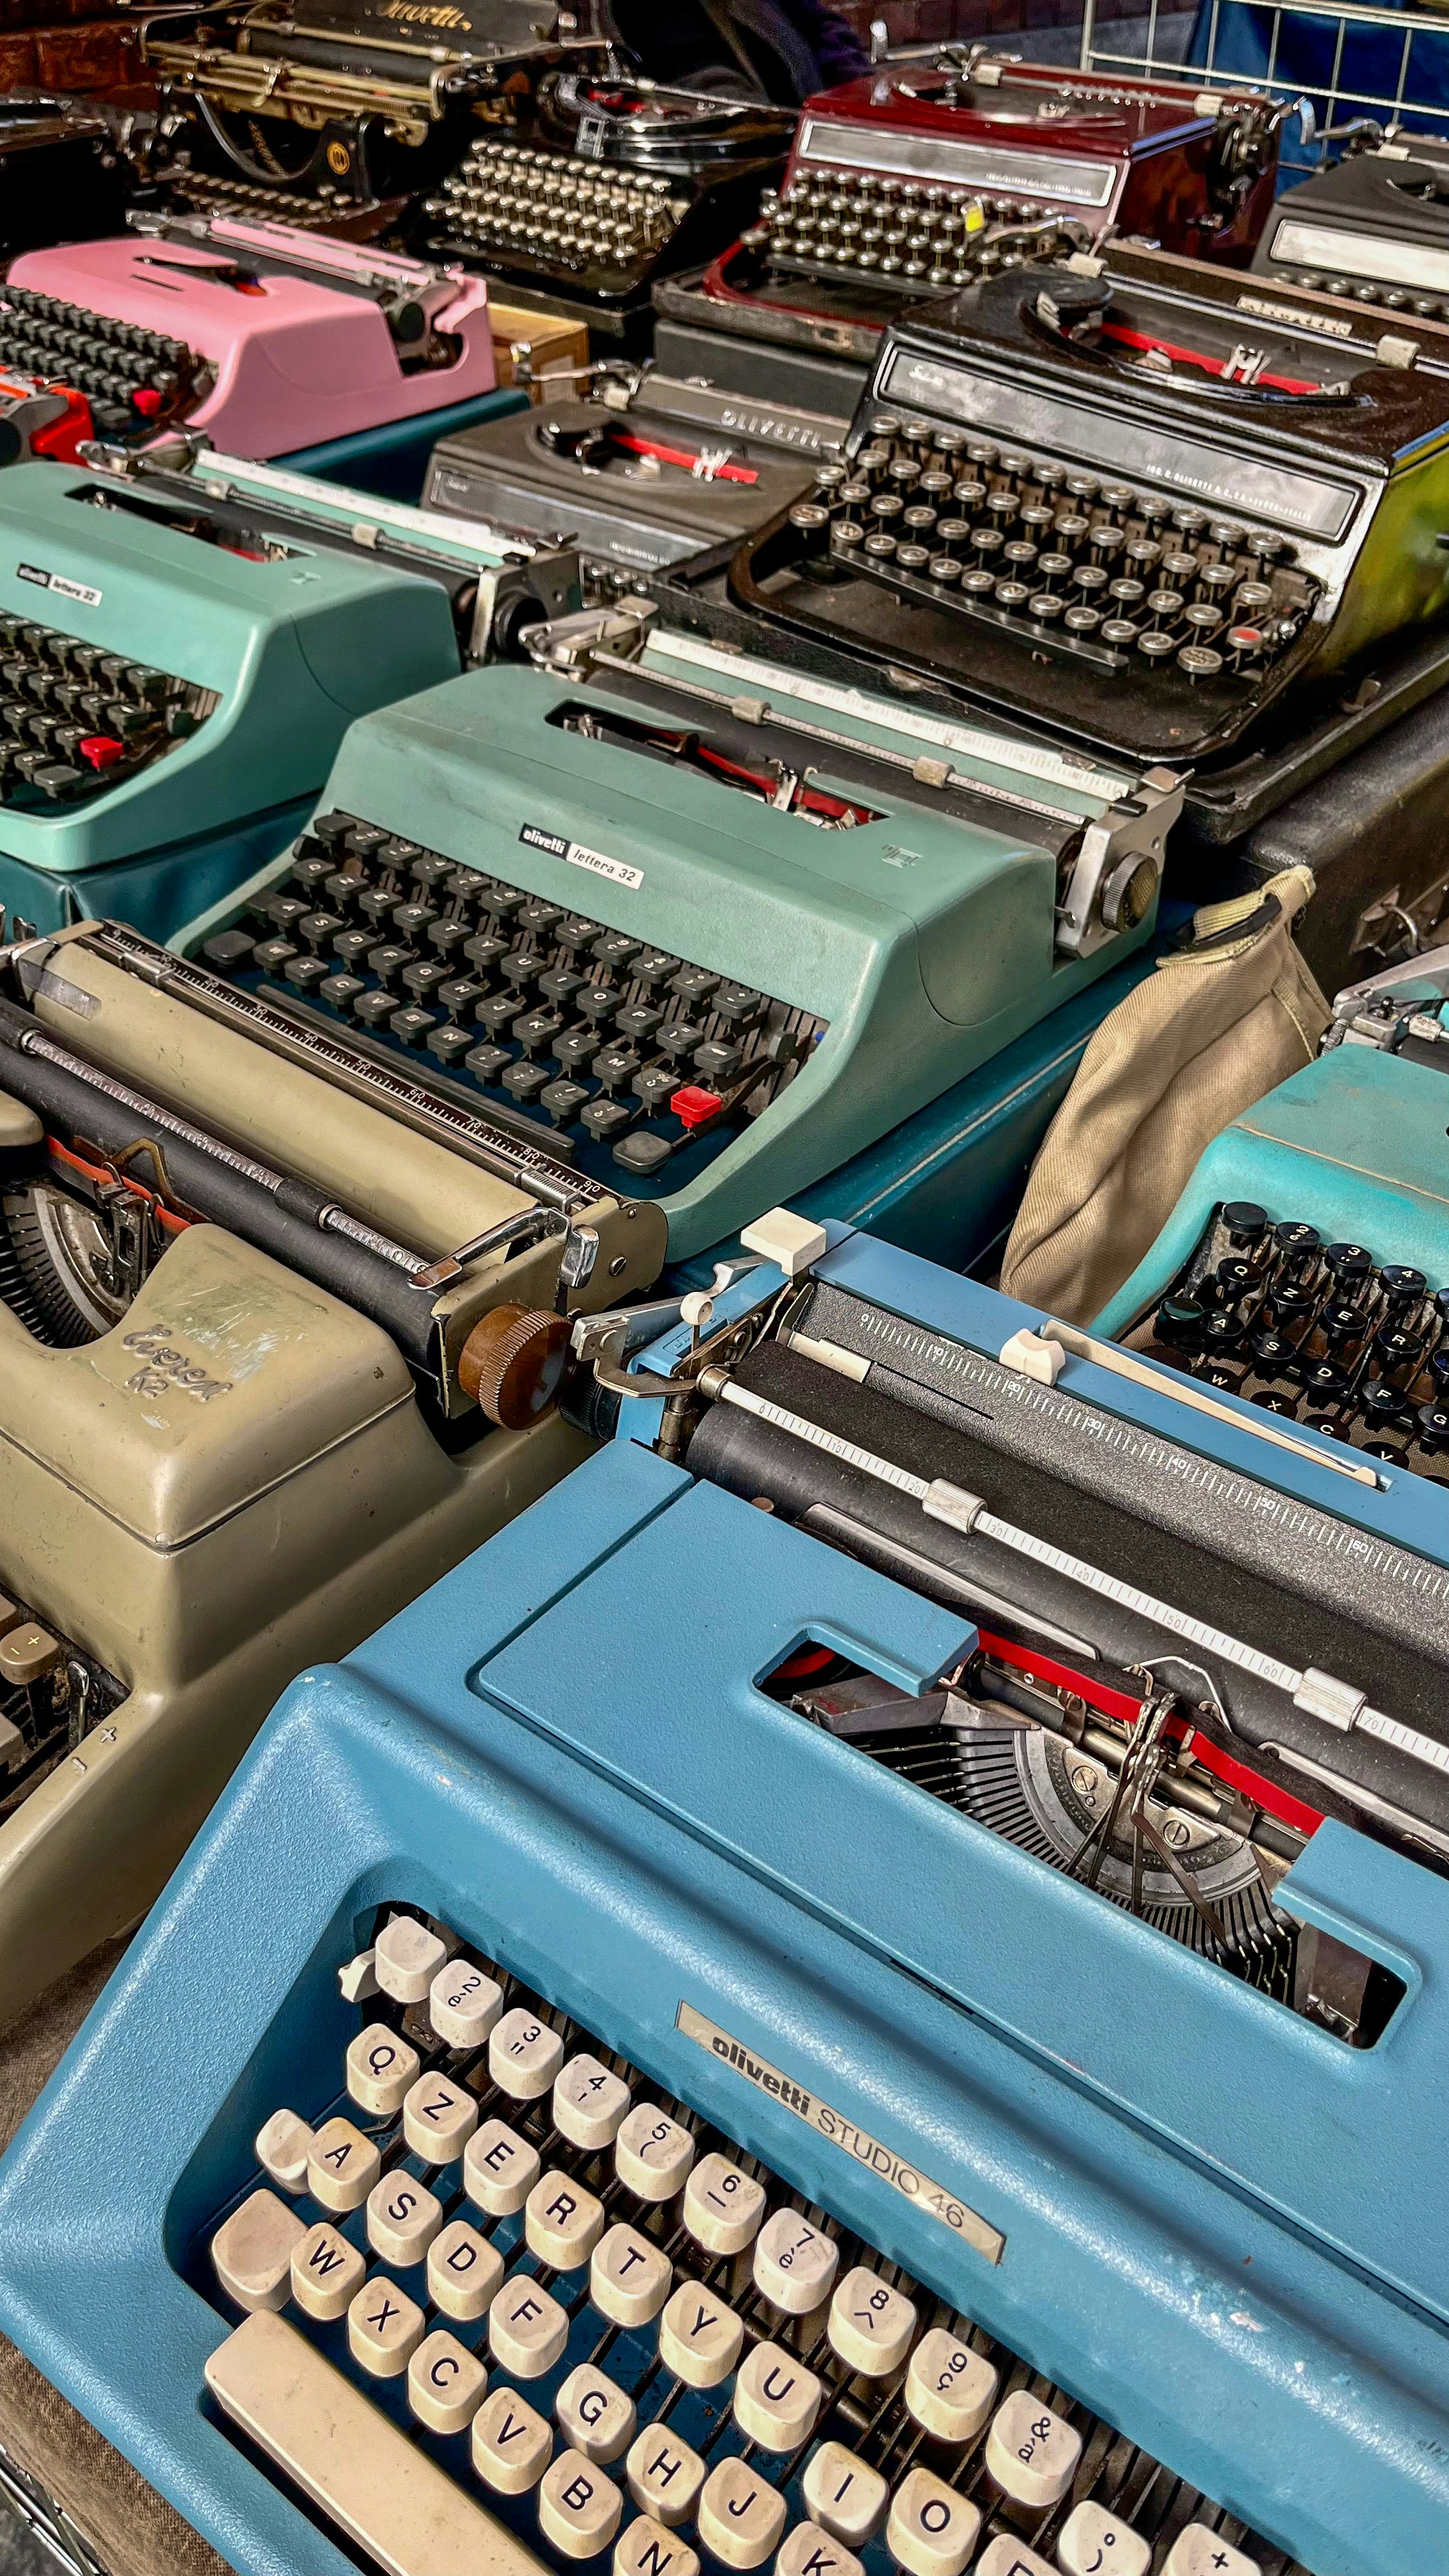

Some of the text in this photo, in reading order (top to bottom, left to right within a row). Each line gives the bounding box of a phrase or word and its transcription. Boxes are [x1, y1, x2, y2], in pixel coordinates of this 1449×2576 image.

[721, 409, 820, 448] OLIVETTI
[523, 829, 636, 882] olivetti lettera 32
[443, 1033, 458, 1041] N
[569, 1039, 579, 1047] L
[608, 1057, 625, 1067] M
[304, 1031, 318, 1043] 40
[356, 1060, 371, 1070] 50
[410, 1088, 425, 1100] 60
[466, 1117, 480, 1129] 70
[523, 1148, 539, 1160] 80
[584, 1181, 601, 1193] 90
[1296, 1225, 1308, 1234] 2
[1347, 1247, 1360, 1256] 3
[1234, 1265, 1248, 1276] Q
[1283, 1287, 1298, 1298] Z
[1214, 1317, 1226, 1328] A
[1338, 1310, 1353, 1321] E
[1266, 1340, 1280, 1351] S
[1392, 1334, 1406, 1345] R
[124, 1365, 169, 1400] K2
[1211, 1373, 1228, 1386] W
[1317, 1367, 1333, 1377] D
[1268, 1400, 1282, 1411] X
[1376, 1389, 1392, 1399] F
[1320, 1424, 1335, 1435] C
[1433, 1414, 1447, 1425] G
[933, 1346, 944, 1356] 10
[1008, 1382, 1021, 1392] 20
[1087, 1418, 1101, 1430] 30
[1172, 1457, 1188, 1469] 40
[1260, 1496, 1276, 1510] 50
[1352, 1541, 1368, 1554] 60
[1380, 1450, 1393, 1461] V
[832, 1443, 841, 1453] 10
[908, 1482, 921, 1494] 20
[990, 1524, 1003, 1537] 30
[1076, 1569, 1089, 1581] 40
[1167, 1617, 1180, 1629] 50
[1264, 1665, 1277, 1678] 60
[1363, 1717, 1379, 1730] 70
[462, 1977, 480, 1993] 2
[523, 2026, 540, 2042] 3
[369, 2045, 395, 2076] Q
[589, 2076, 606, 2092] 4
[422, 2092, 455, 2122] Z
[651, 2122, 671, 2140] 5
[712, 2035, 965, 2228] olivetti STUDIO 46
[325, 2143, 353, 2169] A
[484, 2140, 515, 2171] E
[723, 2174, 742, 2193] 6
[388, 2192, 417, 2220] S
[546, 2192, 577, 2225] R
[795, 2227, 815, 2248] 7
[309, 2239, 346, 2276] W
[447, 2241, 478, 2271] D
[618, 2246, 647, 2274] T
[510, 2297, 543, 2322] F
[870, 2288, 889, 2310] 8
[367, 2298, 401, 2333] X
[690, 2305, 717, 2337] Y
[430, 2357, 459, 2387] C
[948, 2352, 967, 2373] 9
[762, 2366, 796, 2401] U
[579, 2390, 608, 2426] G
[496, 2412, 526, 2445] V
[1031, 2416, 1051, 2442] &
[647, 2448, 682, 2488] H
[561, 2474, 594, 2511] B
[834, 2472, 854, 2503] I
[728, 2490, 756, 2517] J
[920, 2499, 951, 2533] O
[637, 2540, 674, 2576] N
[802, 2547, 837, 2576] K
